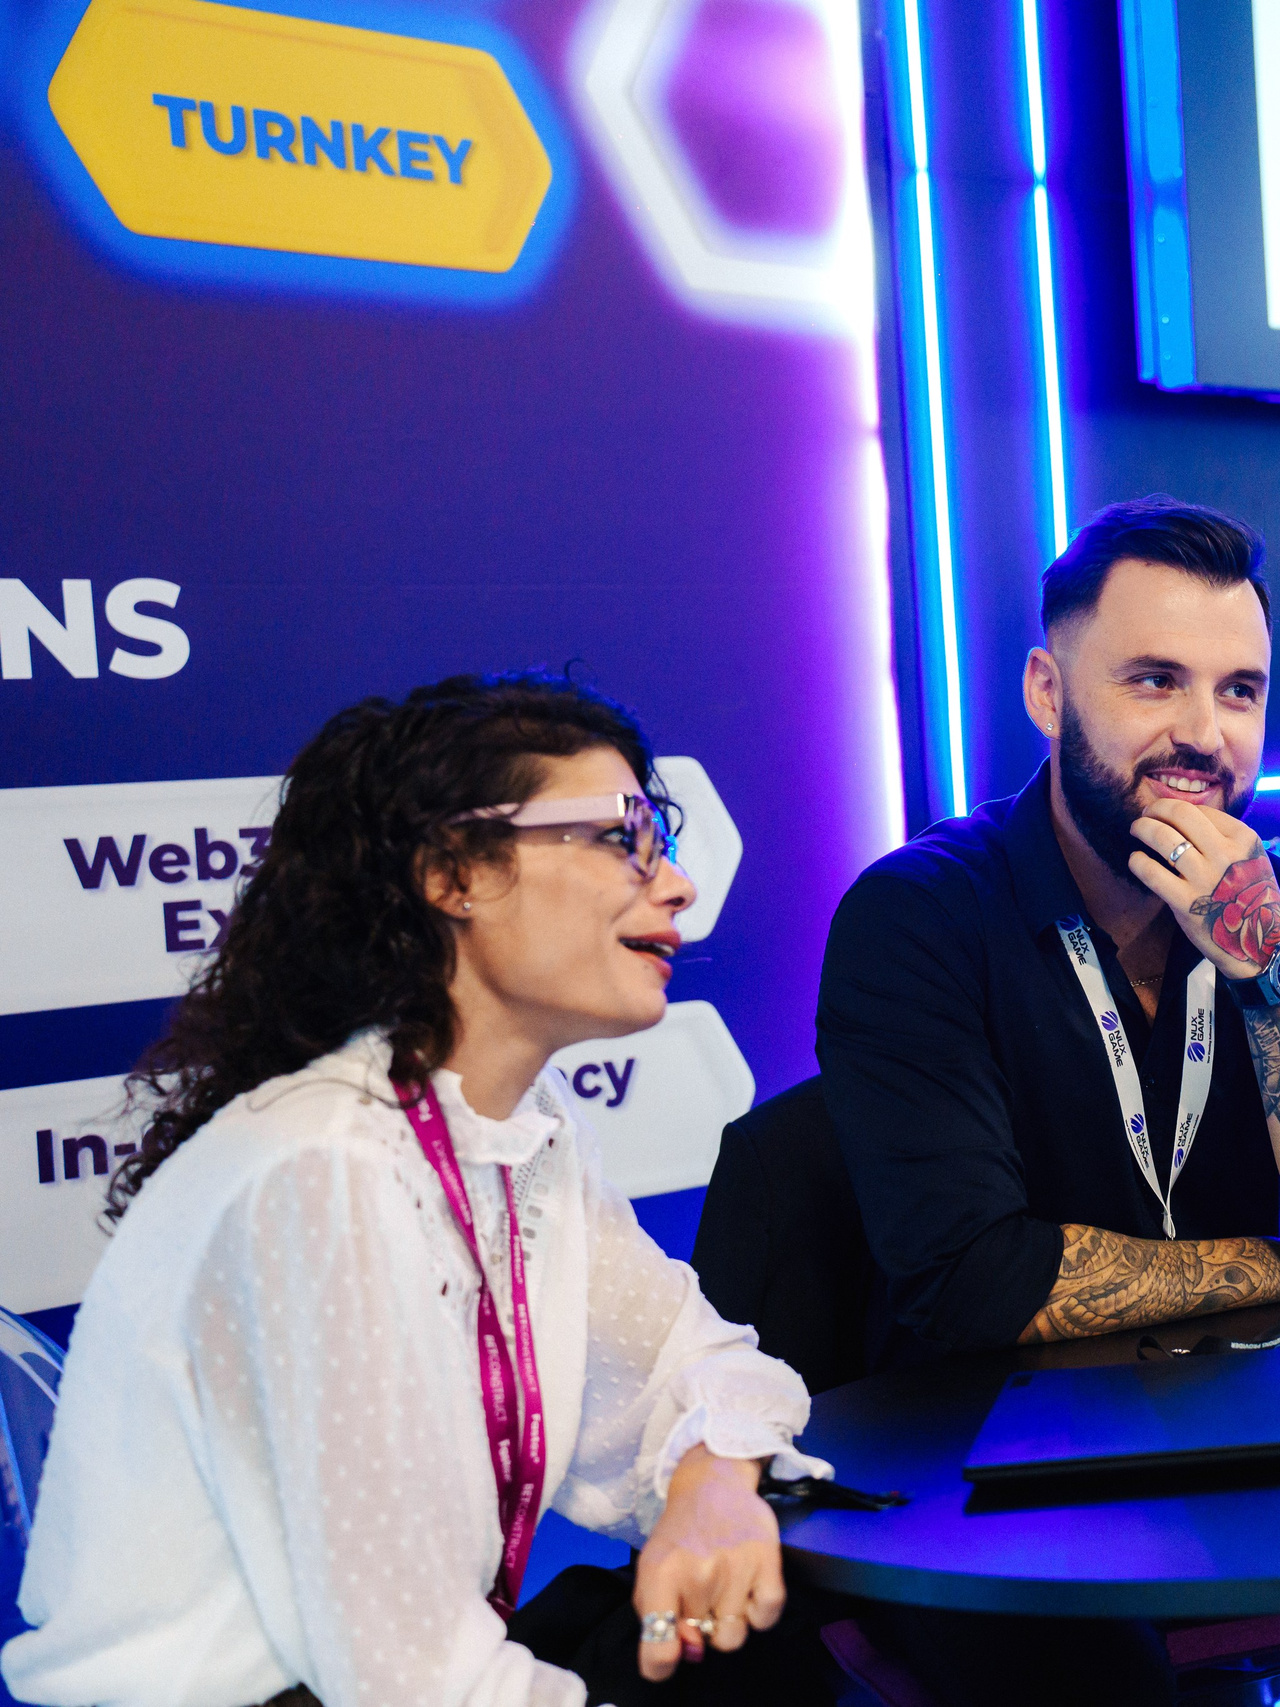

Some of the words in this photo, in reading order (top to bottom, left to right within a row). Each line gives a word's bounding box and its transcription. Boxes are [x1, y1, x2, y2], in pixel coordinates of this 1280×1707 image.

[152, 93, 473, 186] TURNKEY
[1067, 932, 1087, 966] GAME
[1074, 928, 1091, 954] NUX
[1190, 1016, 1199, 1041] NUX
[1197, 1007, 1205, 1042] GAME
[1108, 1033, 1124, 1068] GAME
[1114, 1030, 1127, 1056] NUX
[558, 1058, 635, 1108] cy
[1139, 1132, 1150, 1158] NUX
[1177, 1122, 1186, 1147] NUX
[1181, 1112, 1194, 1147] GAME
[36, 1129, 148, 1184] In-
[1135, 1135, 1150, 1169] GAME
